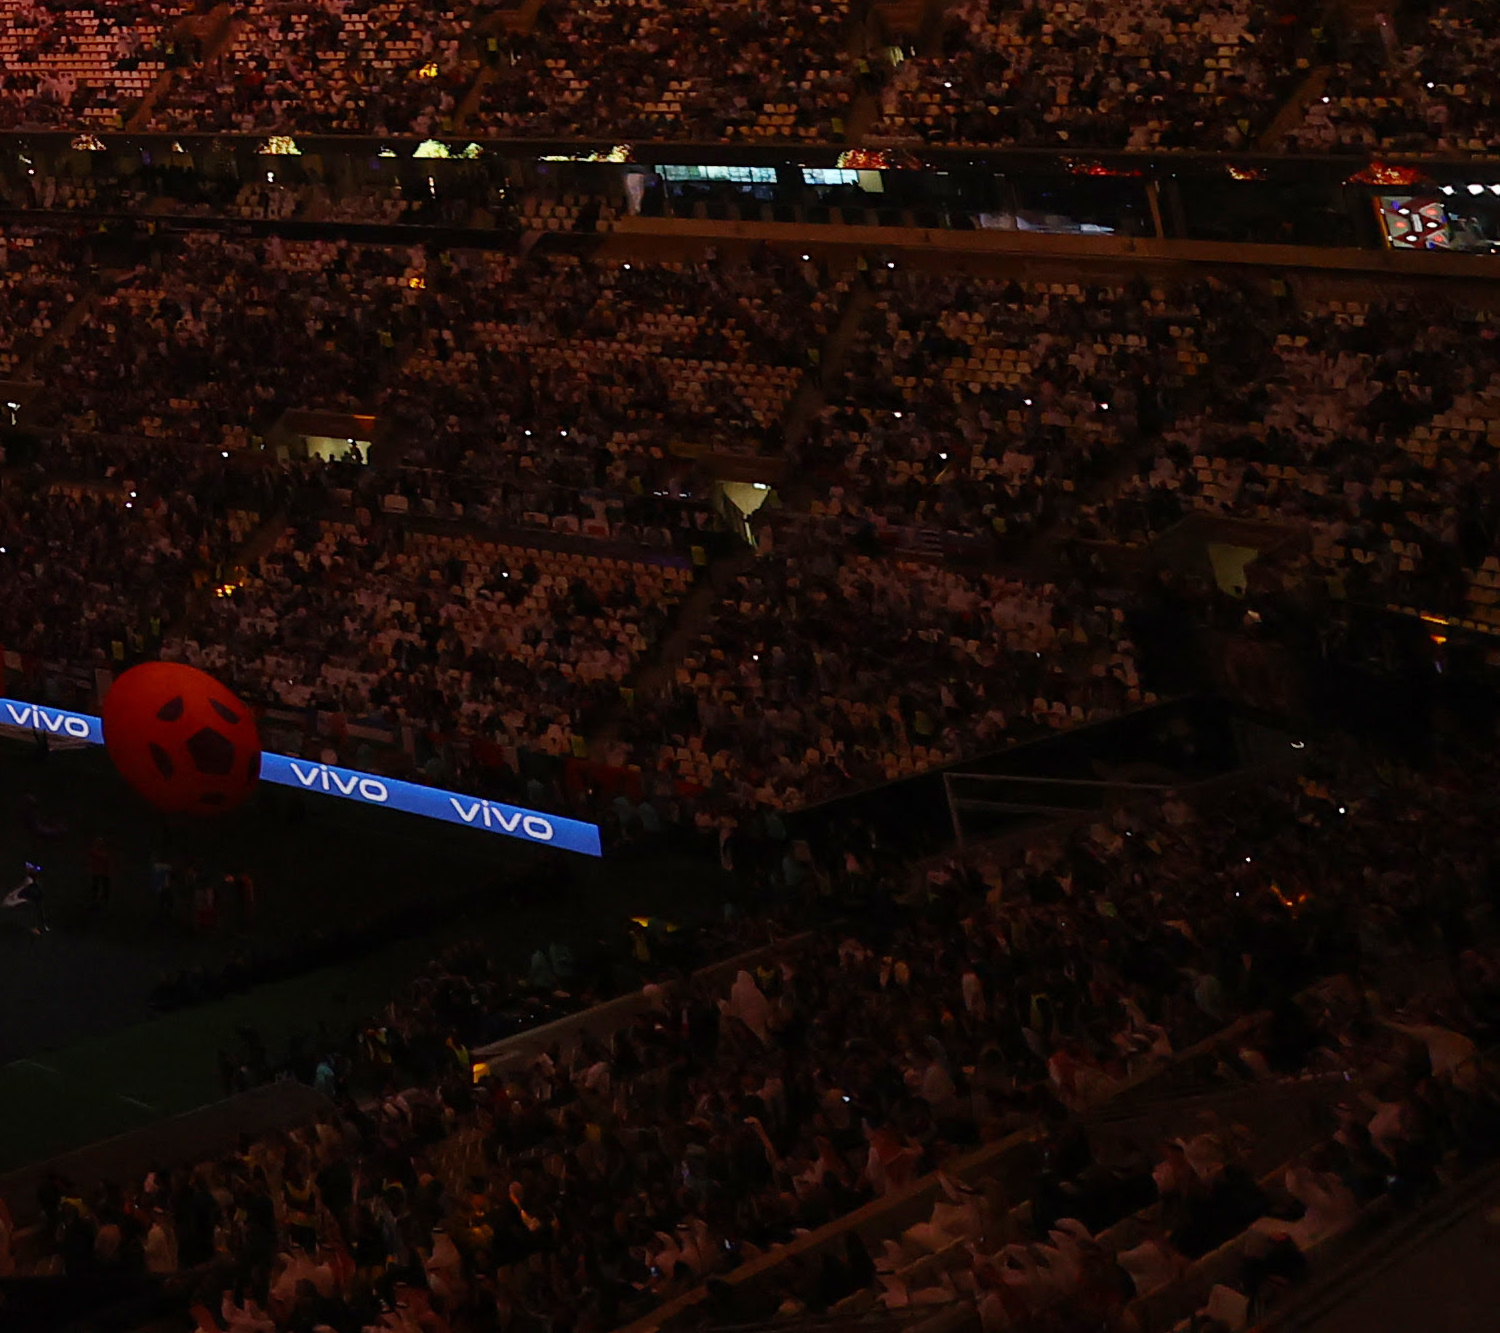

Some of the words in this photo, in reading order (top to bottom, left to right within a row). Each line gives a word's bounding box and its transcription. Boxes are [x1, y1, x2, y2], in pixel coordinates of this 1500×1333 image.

[6, 704, 90, 738] vivo
[290, 762, 388, 802] vivo
[450, 797, 554, 840] vivo
